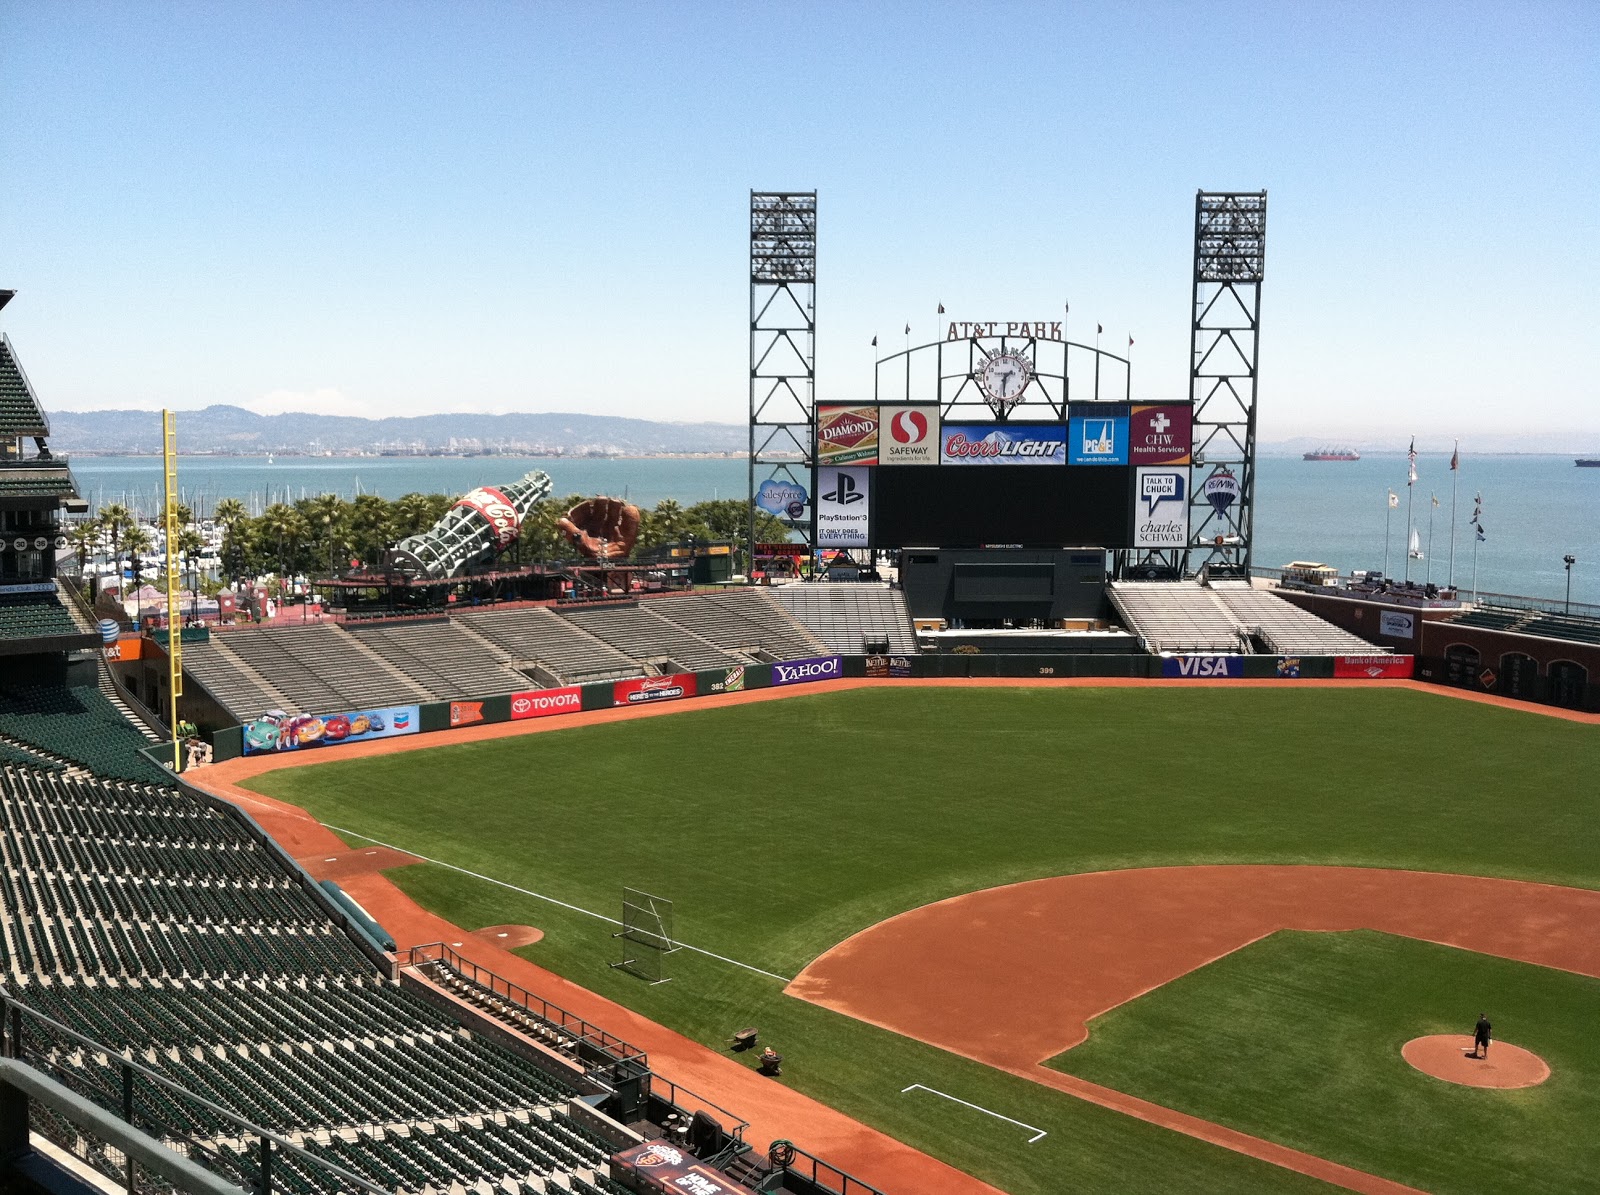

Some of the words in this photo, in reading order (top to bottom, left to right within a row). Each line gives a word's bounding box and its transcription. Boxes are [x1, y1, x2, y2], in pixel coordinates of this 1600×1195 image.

[947, 321, 998, 342] AT&T
[1006, 321, 1062, 341] PARK
[823, 421, 874, 440] DIAMOND
[945, 433, 1000, 457] Coors
[1000, 441, 1061, 456] LIGHT
[1085, 439, 1112, 452] PG&E
[1145, 434, 1174, 444] CHW
[889, 447, 928, 455] SAFEWAY
[1145, 485, 1172, 493] CHUCK
[761, 489, 802, 504] salesforce
[1140, 520, 1182, 533] charles
[1140, 533, 1183, 542] SCHWAB
[1177, 656, 1229, 676] VISA
[1344, 656, 1364, 664] Bank
[1374, 656, 1404, 664] America
[775, 658, 838, 682] YAHOO!
[659, 688, 681, 697] HEROES
[711, 682, 724, 691] 382
[532, 693, 580, 709] TOYOTA
[685, 1172, 722, 1194] HOME
